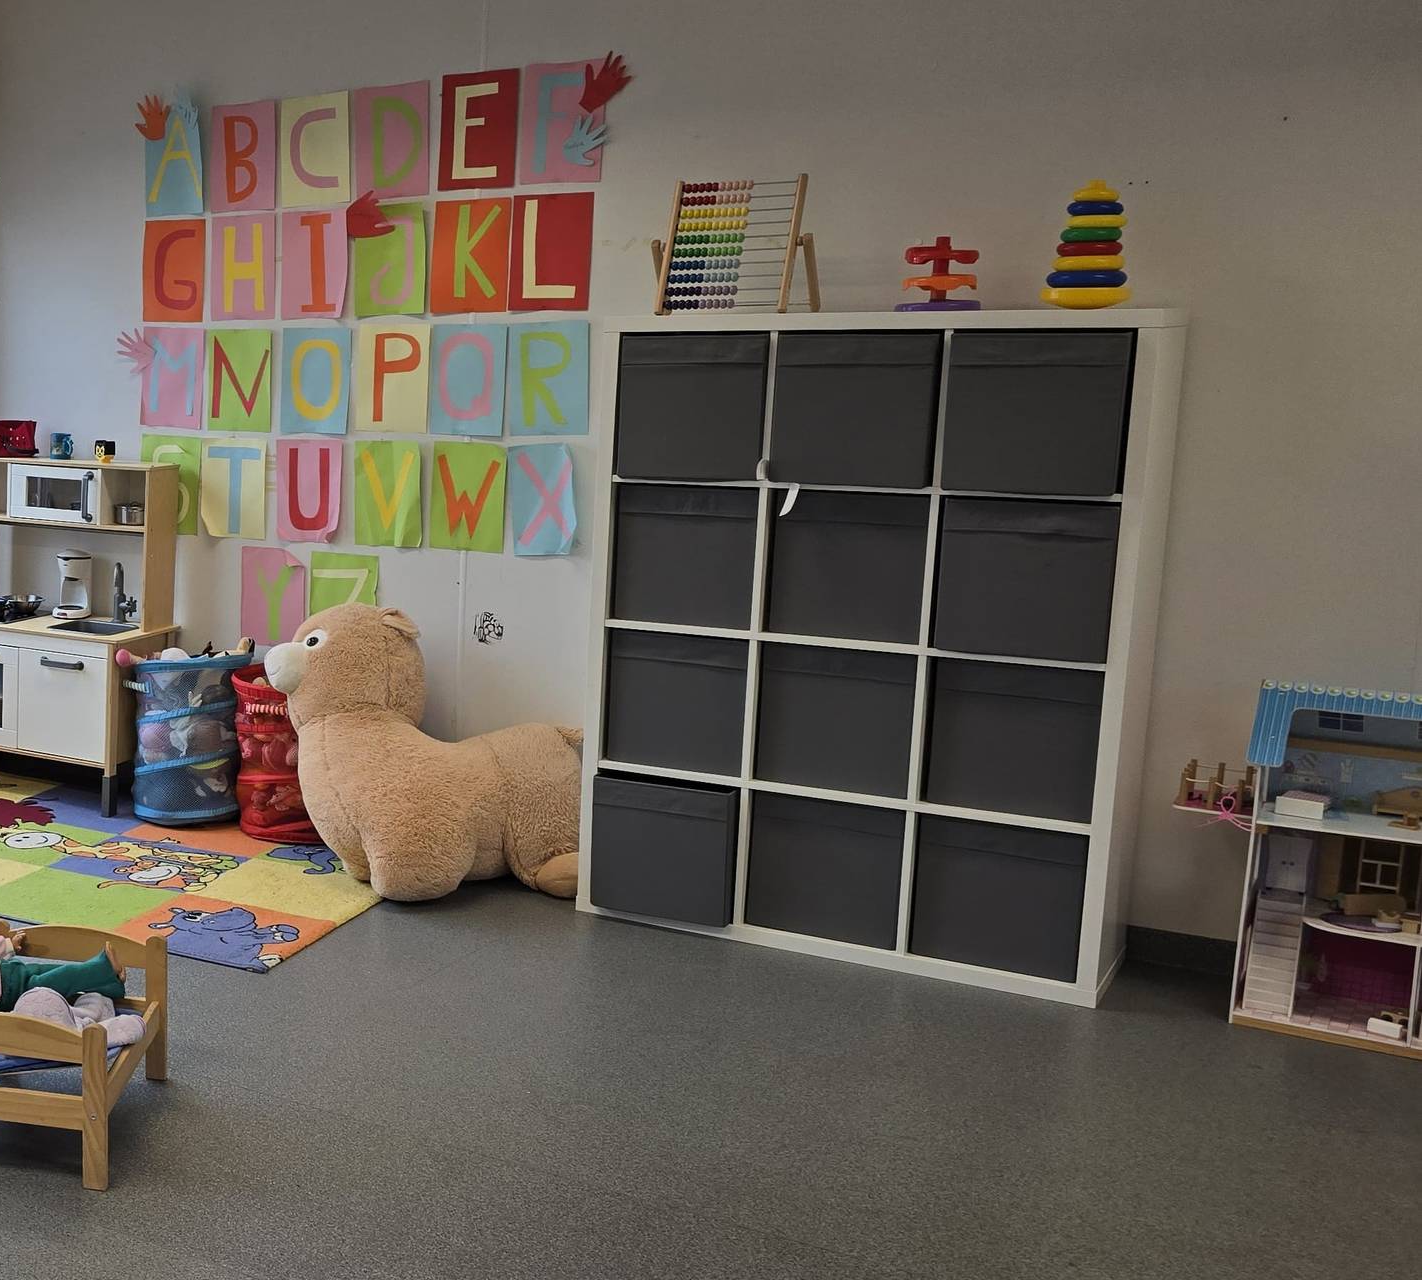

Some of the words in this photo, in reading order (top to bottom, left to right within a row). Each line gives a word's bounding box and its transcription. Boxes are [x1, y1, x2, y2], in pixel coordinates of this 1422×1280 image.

[148, 115, 202, 203] A
[223, 115, 258, 204] B
[289, 107, 340, 189] C
[371, 96, 423, 188] D
[451, 81, 499, 180] E
[532, 71, 584, 174] F
[154, 228, 198, 310] G
[224, 222, 265, 312] H
[300, 212, 336, 312] I
[370, 213, 415, 305] J
[454, 204, 502, 298] K
[522, 199, 576, 299] L
[150, 335, 198, 416] M
[212, 335, 270, 418] N
[291, 339, 342, 421] O
[372, 332, 421, 422] P
[438, 333, 495, 420] Q
[519, 331, 573, 427] R
[208, 446, 261, 534] T
[288, 447, 329, 531] U
[361, 450, 415, 530] V
[438, 453, 501, 540] W
[517, 451, 572, 546] X
[255, 563, 299, 641] Y
